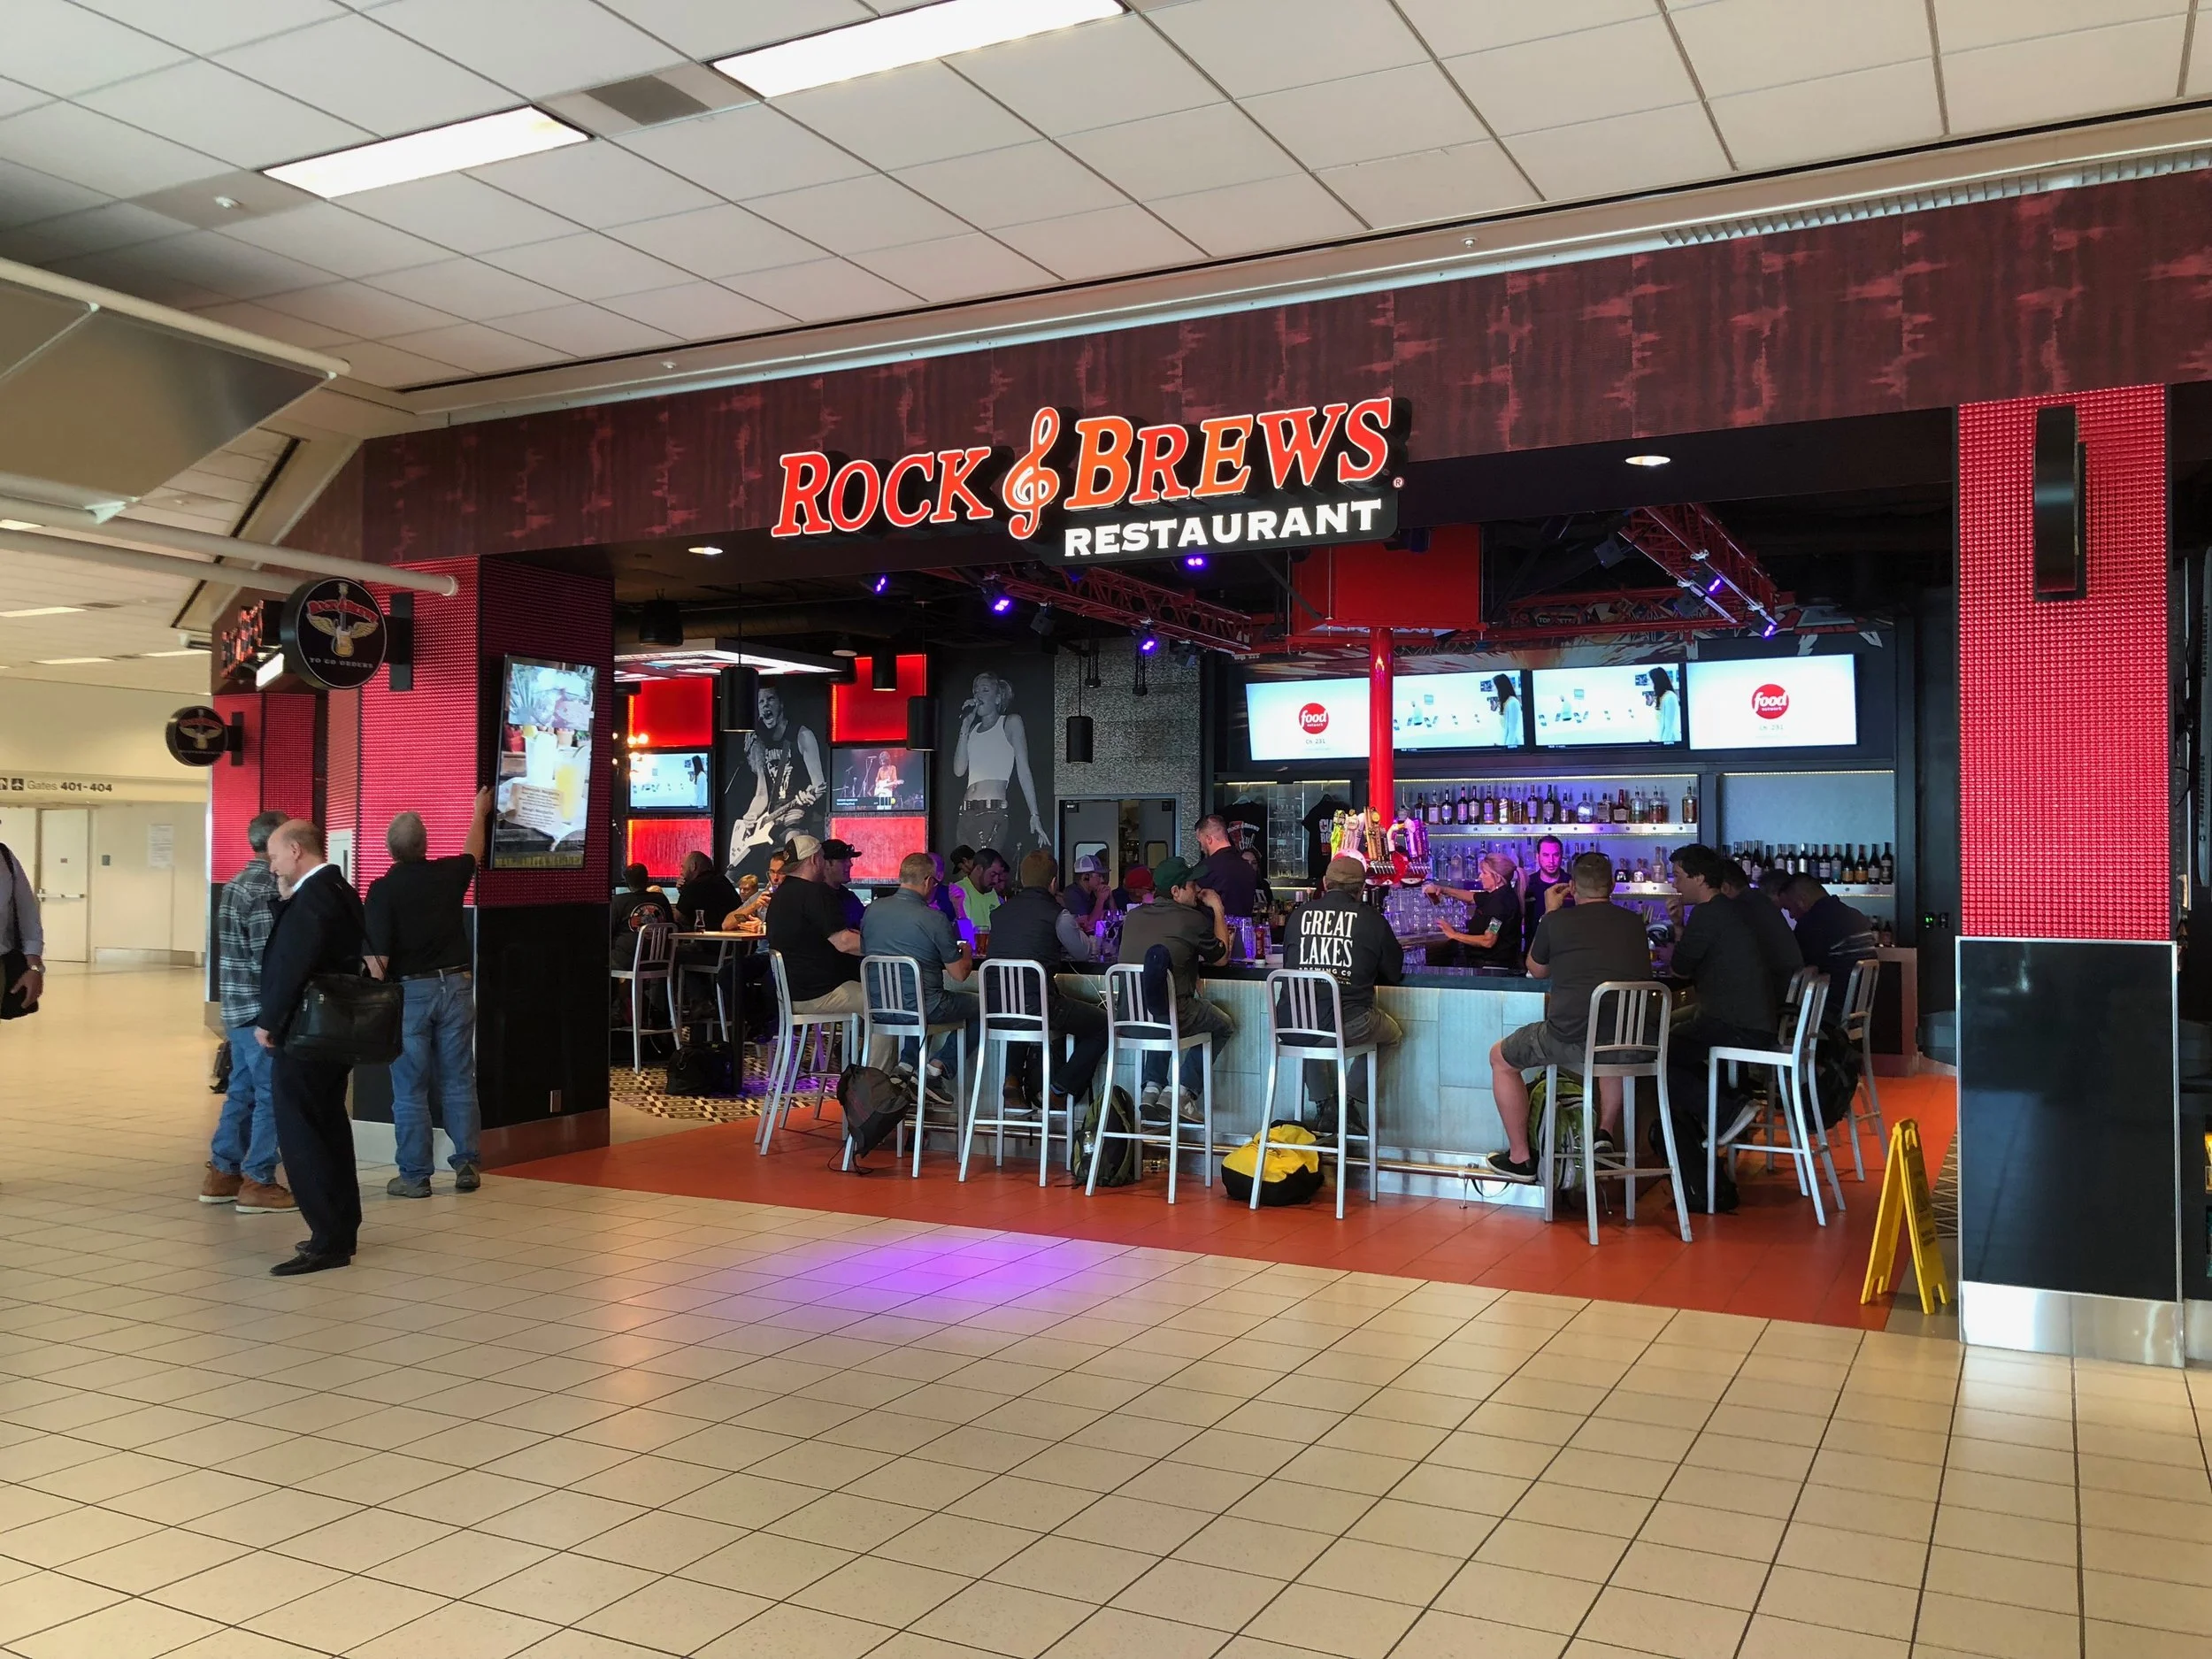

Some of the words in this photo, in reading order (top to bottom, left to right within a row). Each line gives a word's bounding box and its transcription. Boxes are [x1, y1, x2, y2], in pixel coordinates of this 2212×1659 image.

[771, 446, 994, 538] ROCK
[1064, 396, 1392, 511] BREWS
[1064, 498, 1381, 557] RESTAURANT
[1754, 690, 1787, 713] food
[1301, 709, 1328, 727] food
[27, 780, 58, 791] Gates
[60, 781, 112, 792] 401-404
[1301, 910, 1358, 938] GREAT
[1299, 936, 1353, 968] LAKES
